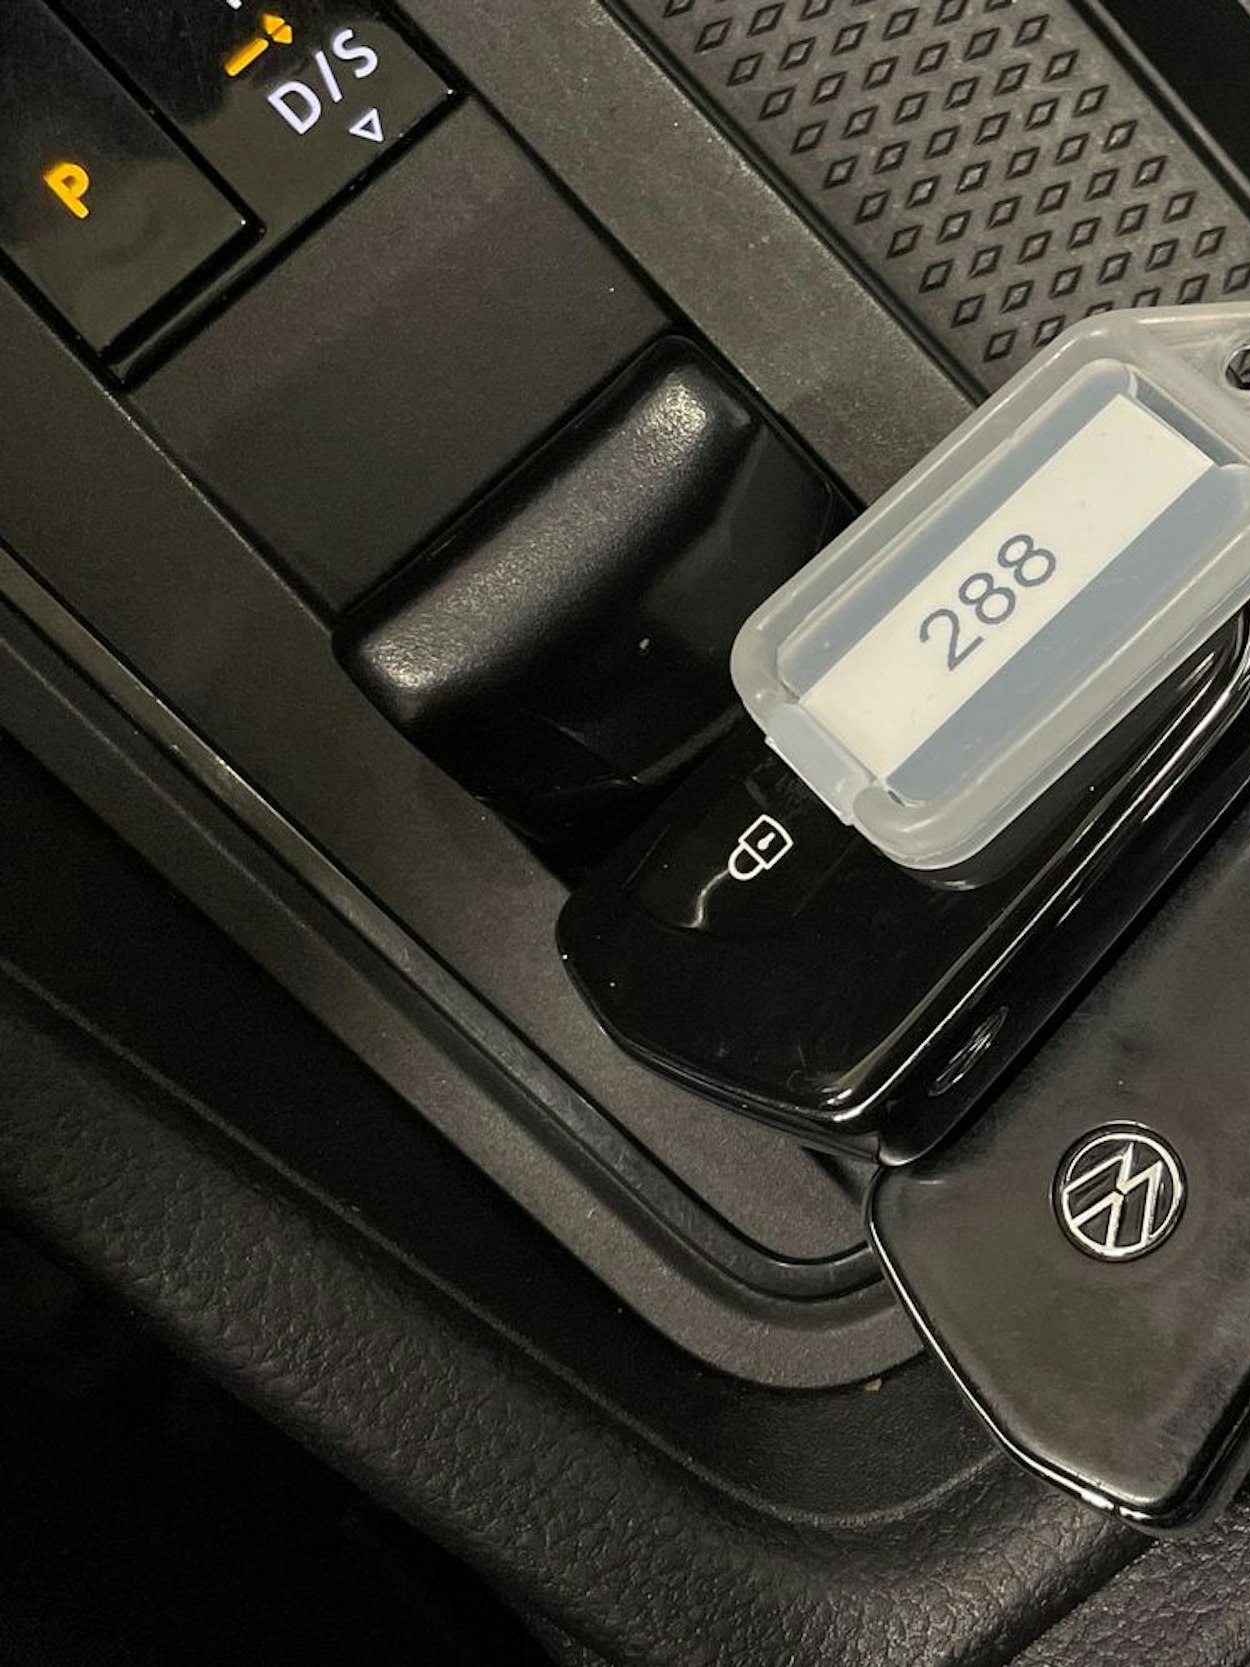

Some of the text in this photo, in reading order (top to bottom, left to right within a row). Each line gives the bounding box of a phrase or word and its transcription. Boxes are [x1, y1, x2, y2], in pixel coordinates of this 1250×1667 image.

[267, 27, 379, 135] D/S
[43, 162, 90, 219] P
[918, 533, 1058, 672] 288
